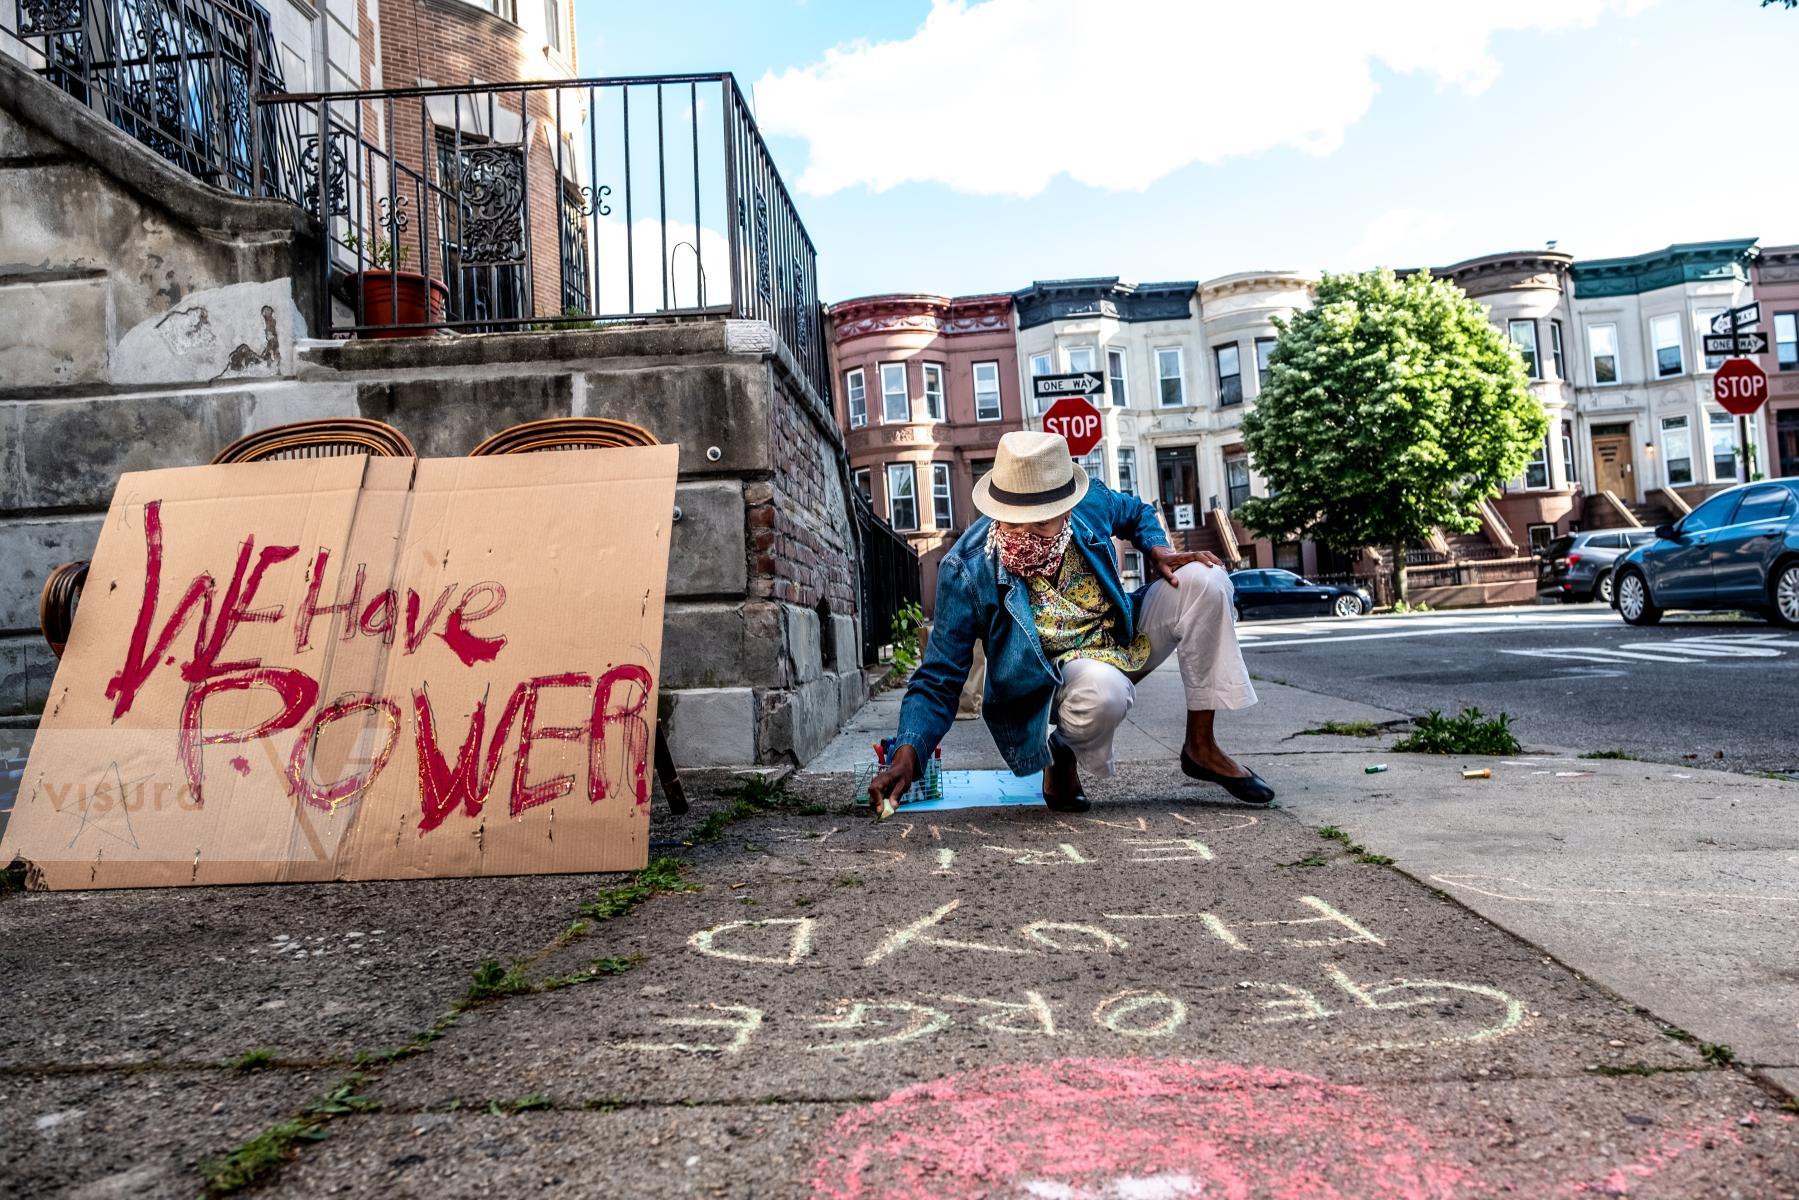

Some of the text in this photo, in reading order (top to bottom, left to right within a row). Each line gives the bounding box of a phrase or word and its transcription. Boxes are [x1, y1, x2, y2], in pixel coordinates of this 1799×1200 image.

[1712, 339, 1758, 349] ONE WAY
[1043, 379, 1094, 391] ONE WAY
[1717, 375, 1764, 398] STOP
[1046, 415, 1098, 438] STOP
[105, 499, 508, 724] WE Have
[177, 662, 652, 836] POWER
[821, 838, 1213, 875] ERIC
[686, 896, 1386, 967] FLOYD
[608, 962, 1525, 1053] GEORGE
